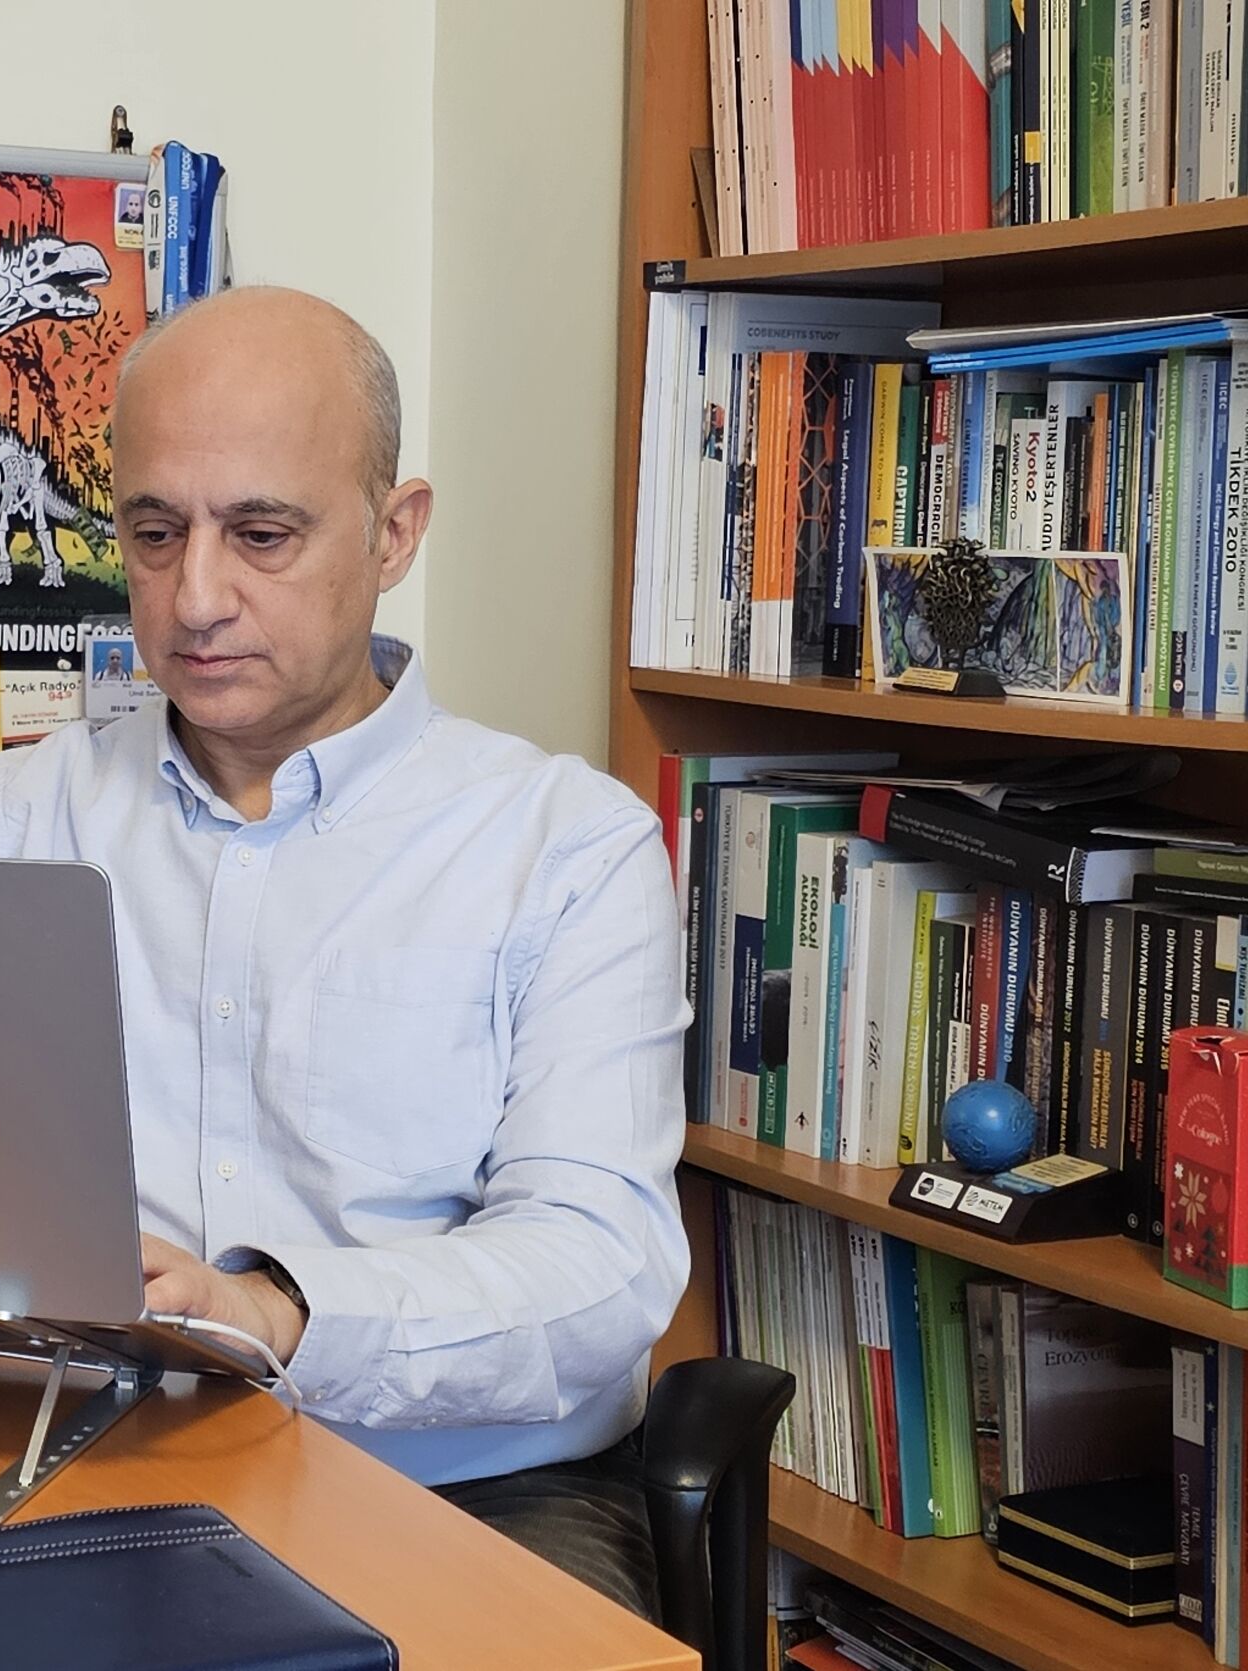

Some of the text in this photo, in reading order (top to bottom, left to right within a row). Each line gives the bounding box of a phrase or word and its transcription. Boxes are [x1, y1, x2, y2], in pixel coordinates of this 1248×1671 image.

[167, 195, 178, 239] UNFCCC
[747, 327, 840, 342] COBENEFITS STUDY
[880, 380, 888, 420] DARWIN
[877, 456, 884, 470] TO
[878, 421, 886, 454] COMES
[1026, 431, 1041, 503] Kyoto2
[1043, 404, 1060, 509] YEŞERTENLER
[892, 465, 909, 548] CAPTURIN
[993, 453, 1004, 523] THE CORPORATE
[1010, 433, 1020, 521] SAVING KYOTO
[1164, 490, 1174, 522] ÇEVRE
[1166, 474, 1175, 487] VE
[1225, 446, 1242, 573] TİKDEK 2010
[833, 430, 851, 609] Legal Aspects of Carbon Trading
[1161, 523, 1172, 583] KORUMANIN
[1209, 505, 1221, 636] Energy and Climate Research Review
[1158, 622, 1170, 691] SEMPOZYUMU
[798, 874, 809, 948] ALMANAĞI
[808, 876, 820, 949] EKOLOJİ
[1065, 910, 1078, 962] DÜNYANIN
[1002, 901, 1022, 1063] DÜNYANIN DURUMU 2010
[1034, 907, 1048, 1000] DÜNYANIN DURUMU
[1163, 928, 1176, 990] DÜNYANIN
[1191, 929, 1203, 992] DÜNYANIN
[1063, 964, 1075, 1010] DURUMU
[1135, 924, 1150, 1065] DÜNYANIN DURUMU 2014
[1161, 992, 1174, 1044] DURUMU
[977, 1003, 990, 1066] DÜNYANIN
[1062, 1010, 1072, 1033] 2012
[1098, 918, 1114, 1149] DÜNYANIN DURUMU SÜRDÜRÜLEBİLİRLİK
[1089, 1077, 1101, 1150] MÜMKÜN MÜ?
[1179, 1473, 1190, 1509] ÇEVRE
